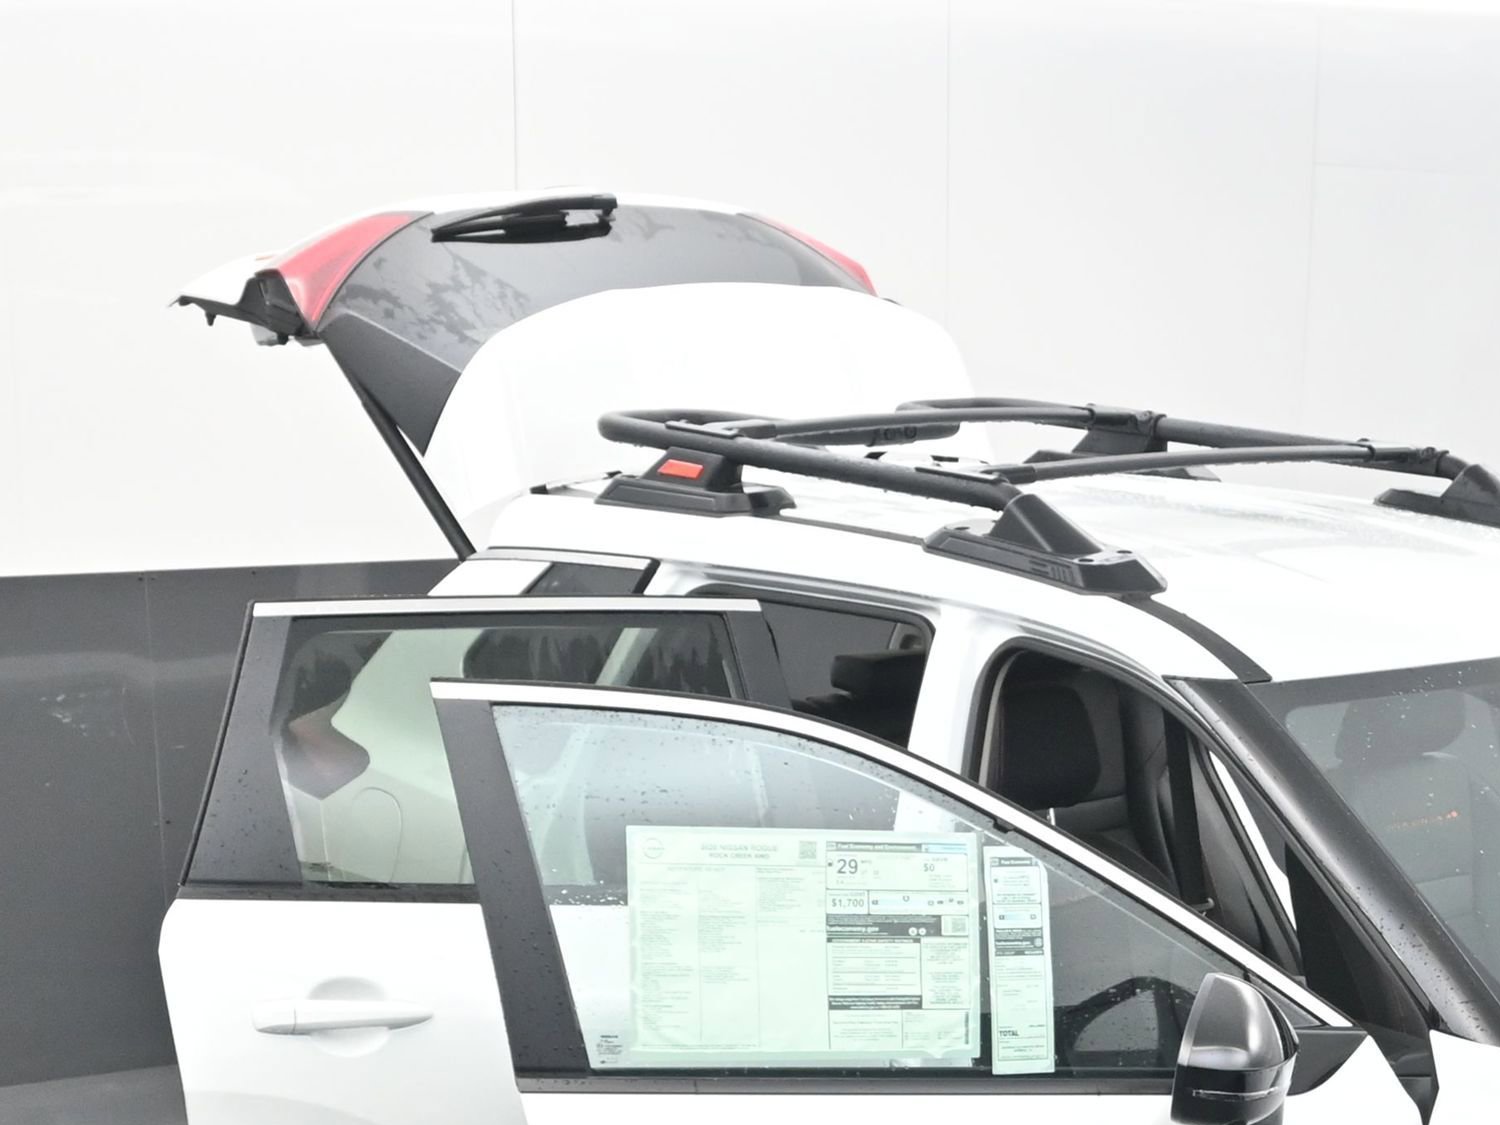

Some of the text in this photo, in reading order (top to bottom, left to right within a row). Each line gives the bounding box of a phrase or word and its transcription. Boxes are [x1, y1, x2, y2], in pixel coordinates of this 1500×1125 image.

[836, 858, 859, 875] 29
[923, 862, 935, 872] $0
[831, 898, 865, 909] $1,700
[999, 1029, 1020, 1037] TOTAL
